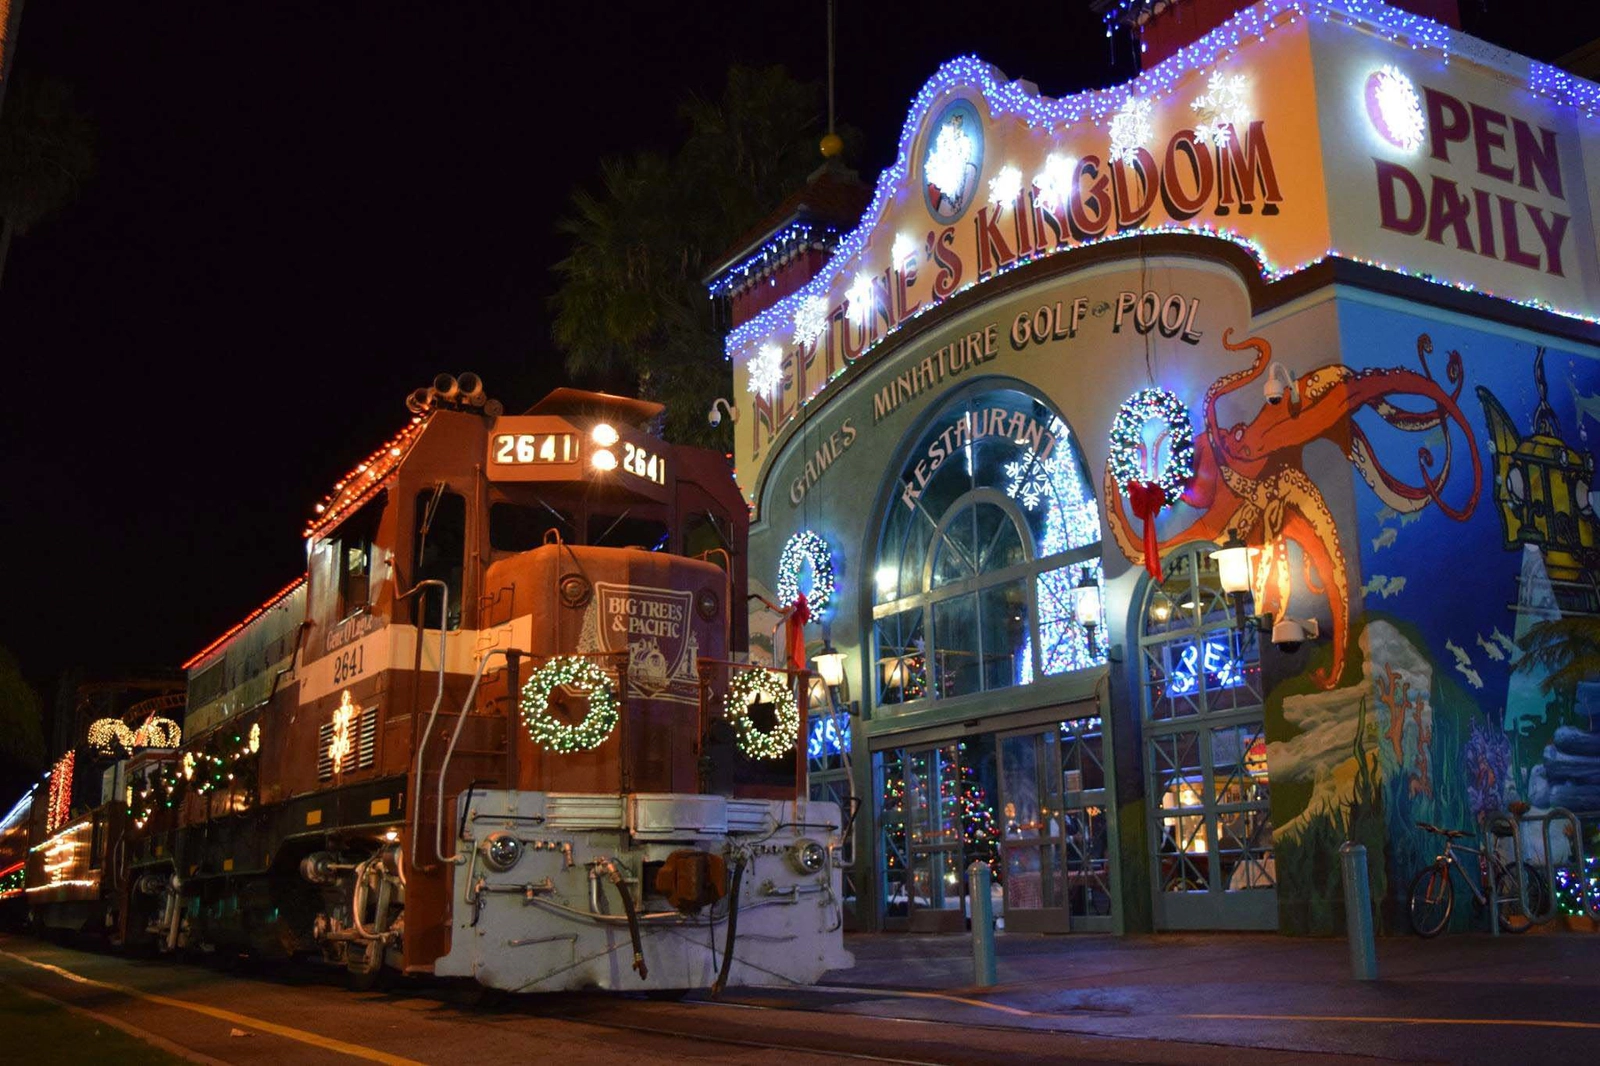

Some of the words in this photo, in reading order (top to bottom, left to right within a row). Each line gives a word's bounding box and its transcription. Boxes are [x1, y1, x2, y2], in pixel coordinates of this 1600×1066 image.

[1371, 157, 1571, 277] DAILY
[753, 227, 962, 458] NEPTUNE'S
[975, 121, 1283, 277] KINGDOM
[790, 417, 857, 505] GAMES
[873, 323, 999, 422] MINIATURE
[1011, 297, 1088, 348] GOLF
[1115, 291, 1203, 342] POOL
[497, 435, 571, 463] 2641
[623, 442, 665, 485] 2641
[902, 408, 1056, 511] RESTAURANT
[609, 597, 637, 615] BIG
[640, 600, 683, 620] TREES
[612, 615, 628, 632] &
[628, 617, 680, 638] PACIFIC
[333, 645, 364, 685] 2641
